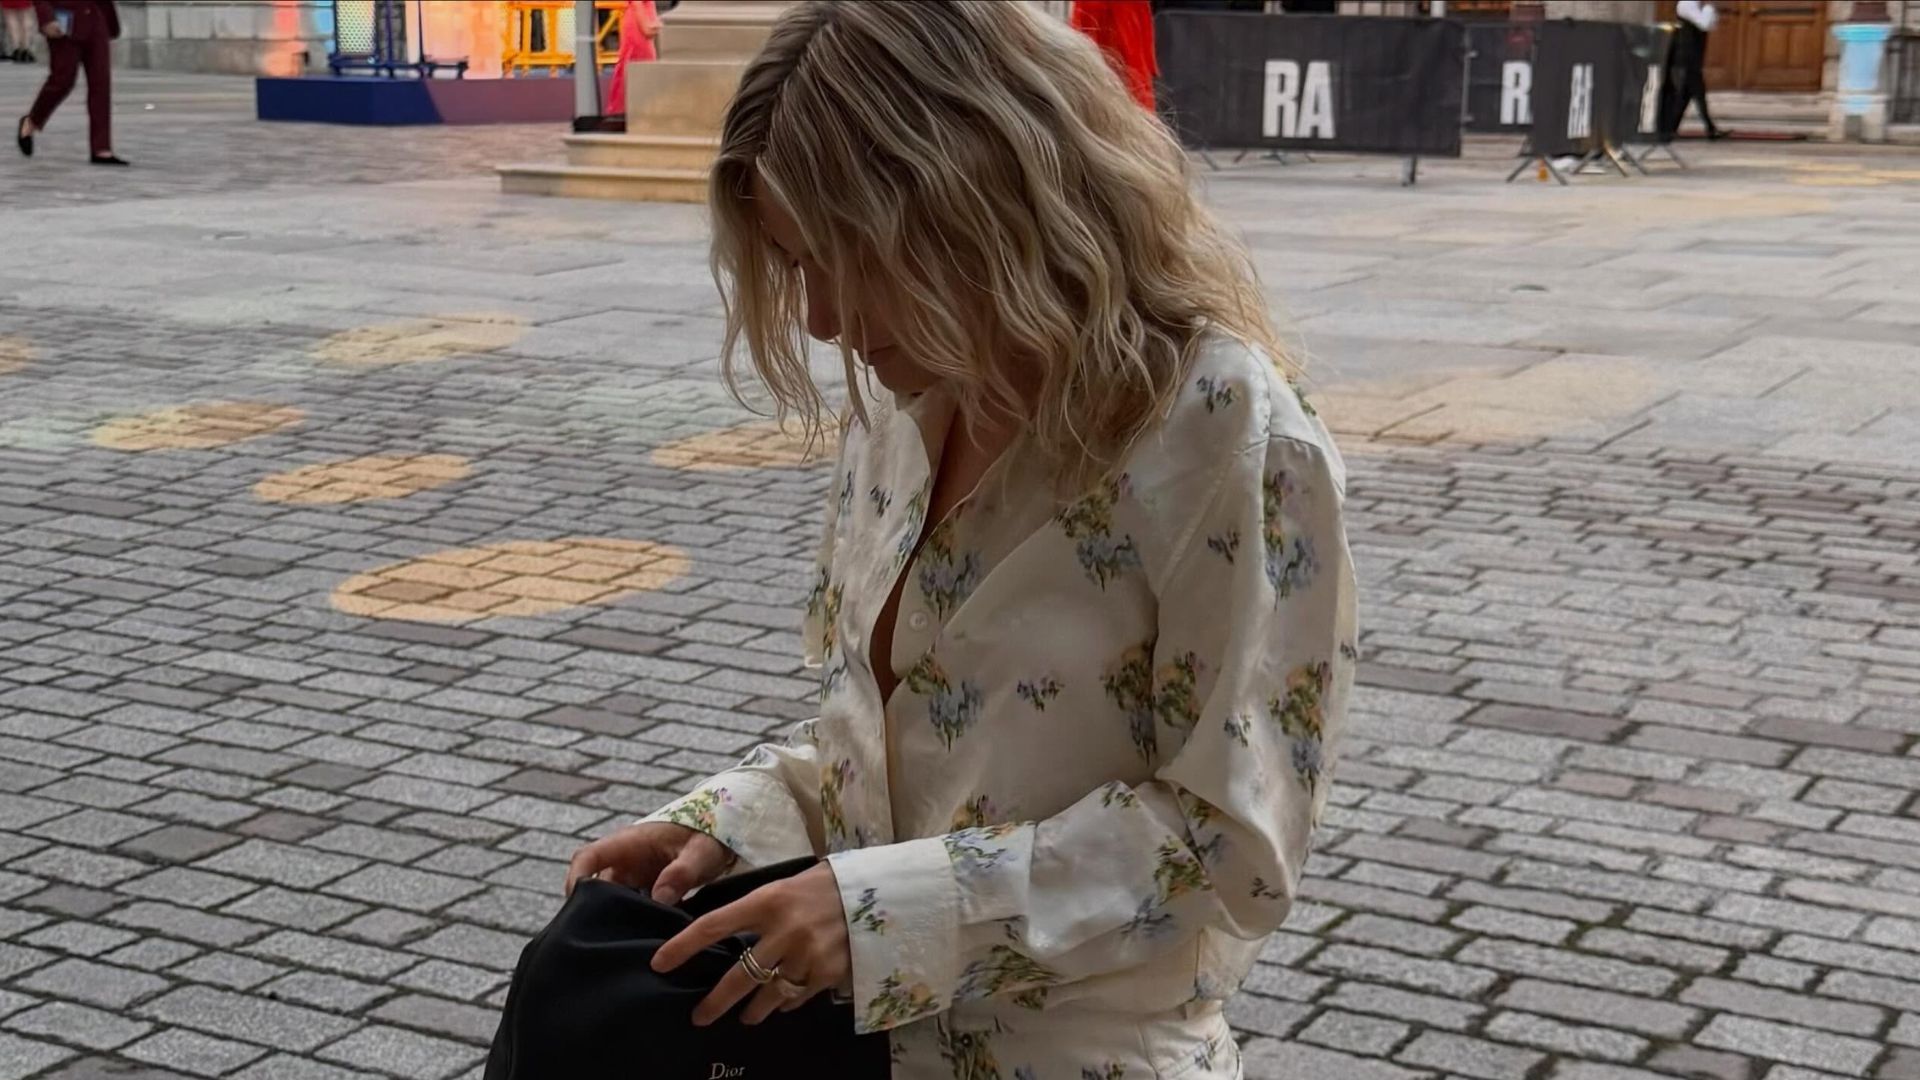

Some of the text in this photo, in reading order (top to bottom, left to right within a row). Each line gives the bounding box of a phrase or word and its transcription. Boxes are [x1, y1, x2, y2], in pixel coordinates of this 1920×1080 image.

[1262, 59, 1335, 139] RA
[1500, 60, 1533, 125] R
[709, 1062, 746, 1080] Dior
